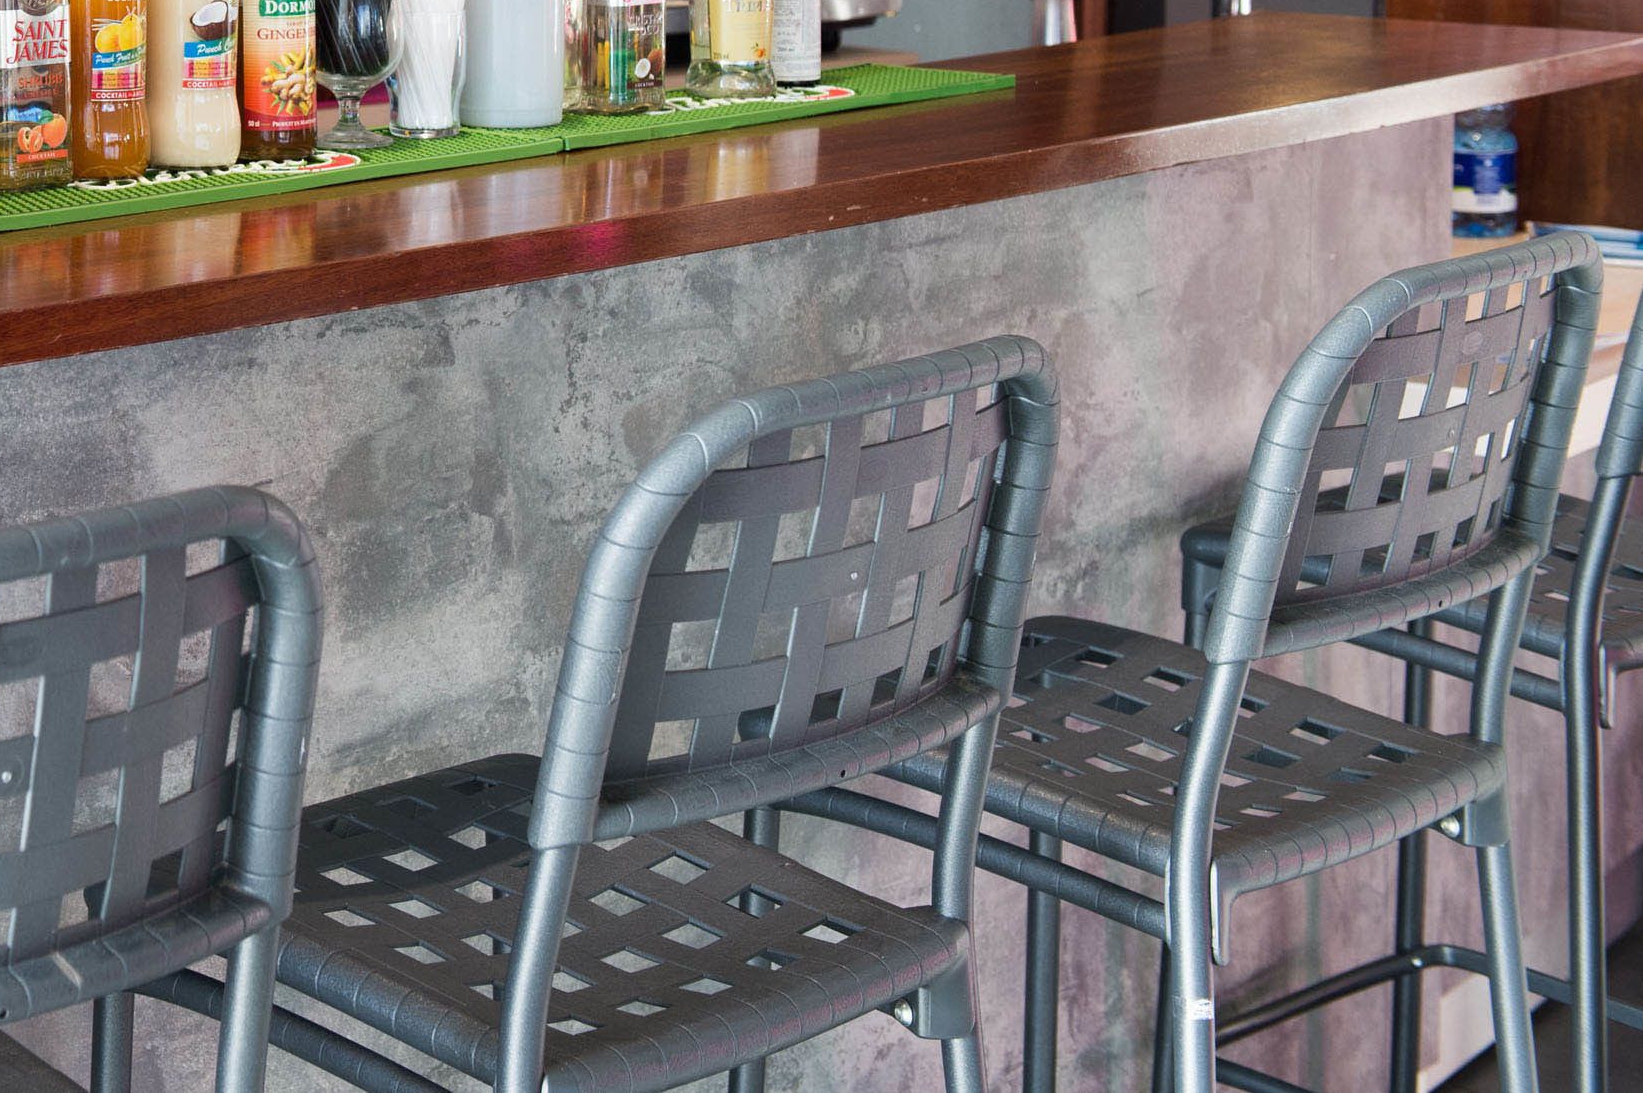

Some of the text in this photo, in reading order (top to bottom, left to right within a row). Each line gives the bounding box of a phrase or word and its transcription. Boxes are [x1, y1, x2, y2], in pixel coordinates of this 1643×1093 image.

[13, 19, 68, 42] SAINT
[6, 39, 69, 64] JAMES
[96, 90, 128, 99] COCKTAIL
